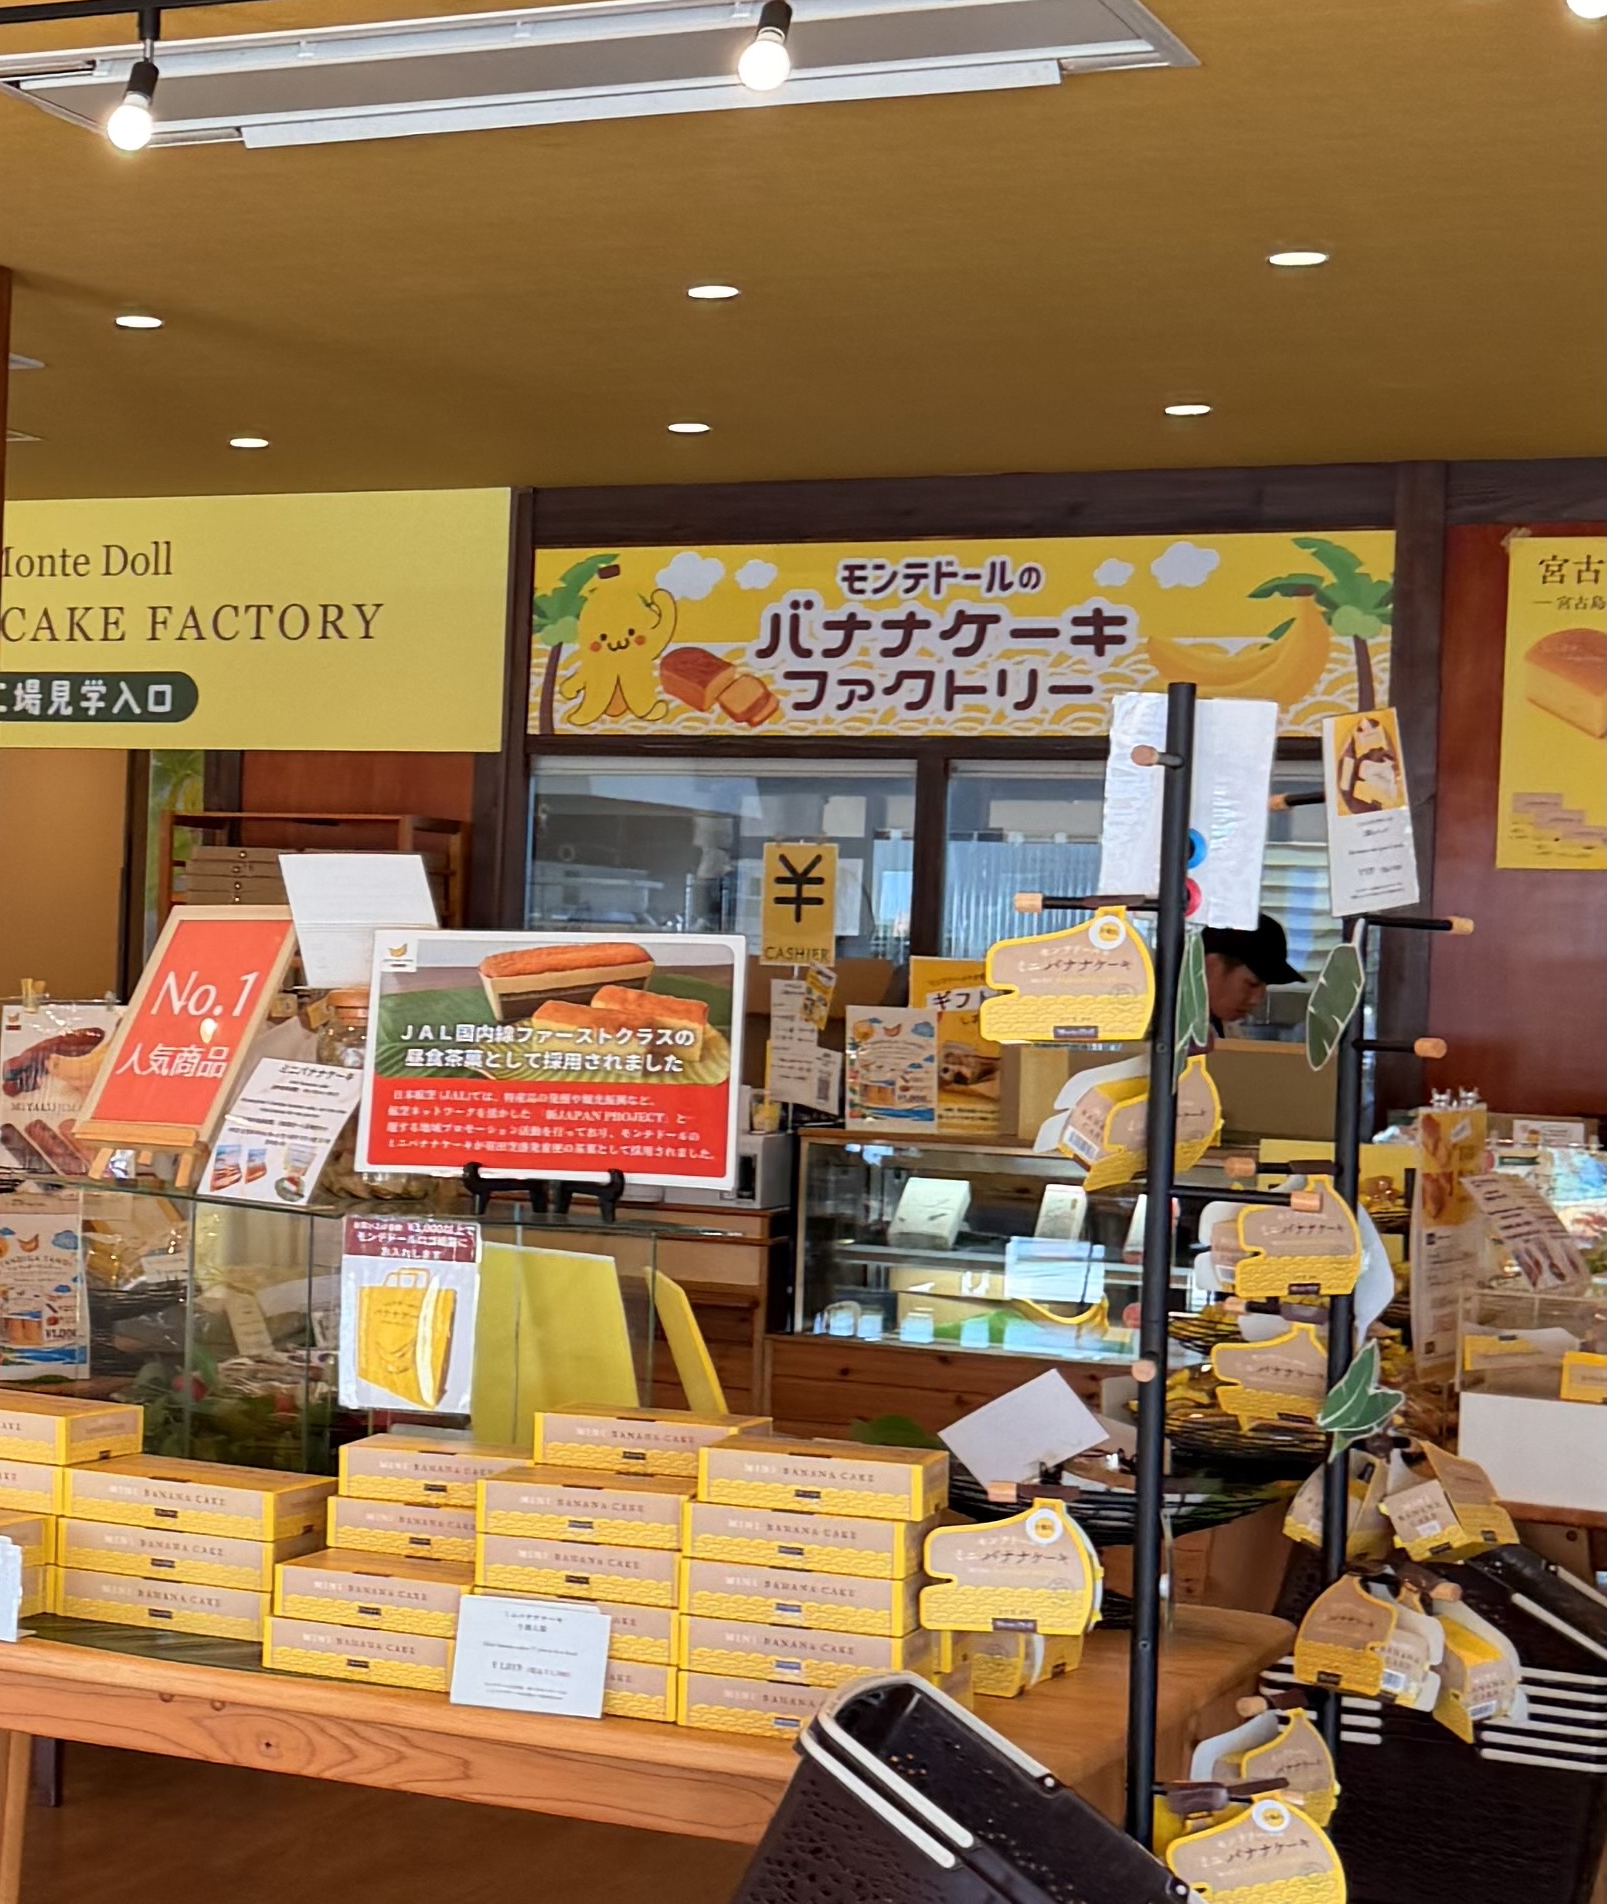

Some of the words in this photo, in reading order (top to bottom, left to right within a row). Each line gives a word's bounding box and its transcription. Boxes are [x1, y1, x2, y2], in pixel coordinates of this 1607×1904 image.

[101, 541, 173, 578] Doll
[840, 559, 1042, 596] モンテドールの
[0, 605, 126, 642] CAKE
[146, 602, 385, 642] FACTORY
[758, 600, 1130, 661] バナナケーキ
[783, 666, 1098, 714] ファクトリー
[764, 946, 830, 962] CASHIER
[149, 970, 260, 1017] No.1
[114, 1042, 230, 1079] 人気商品
